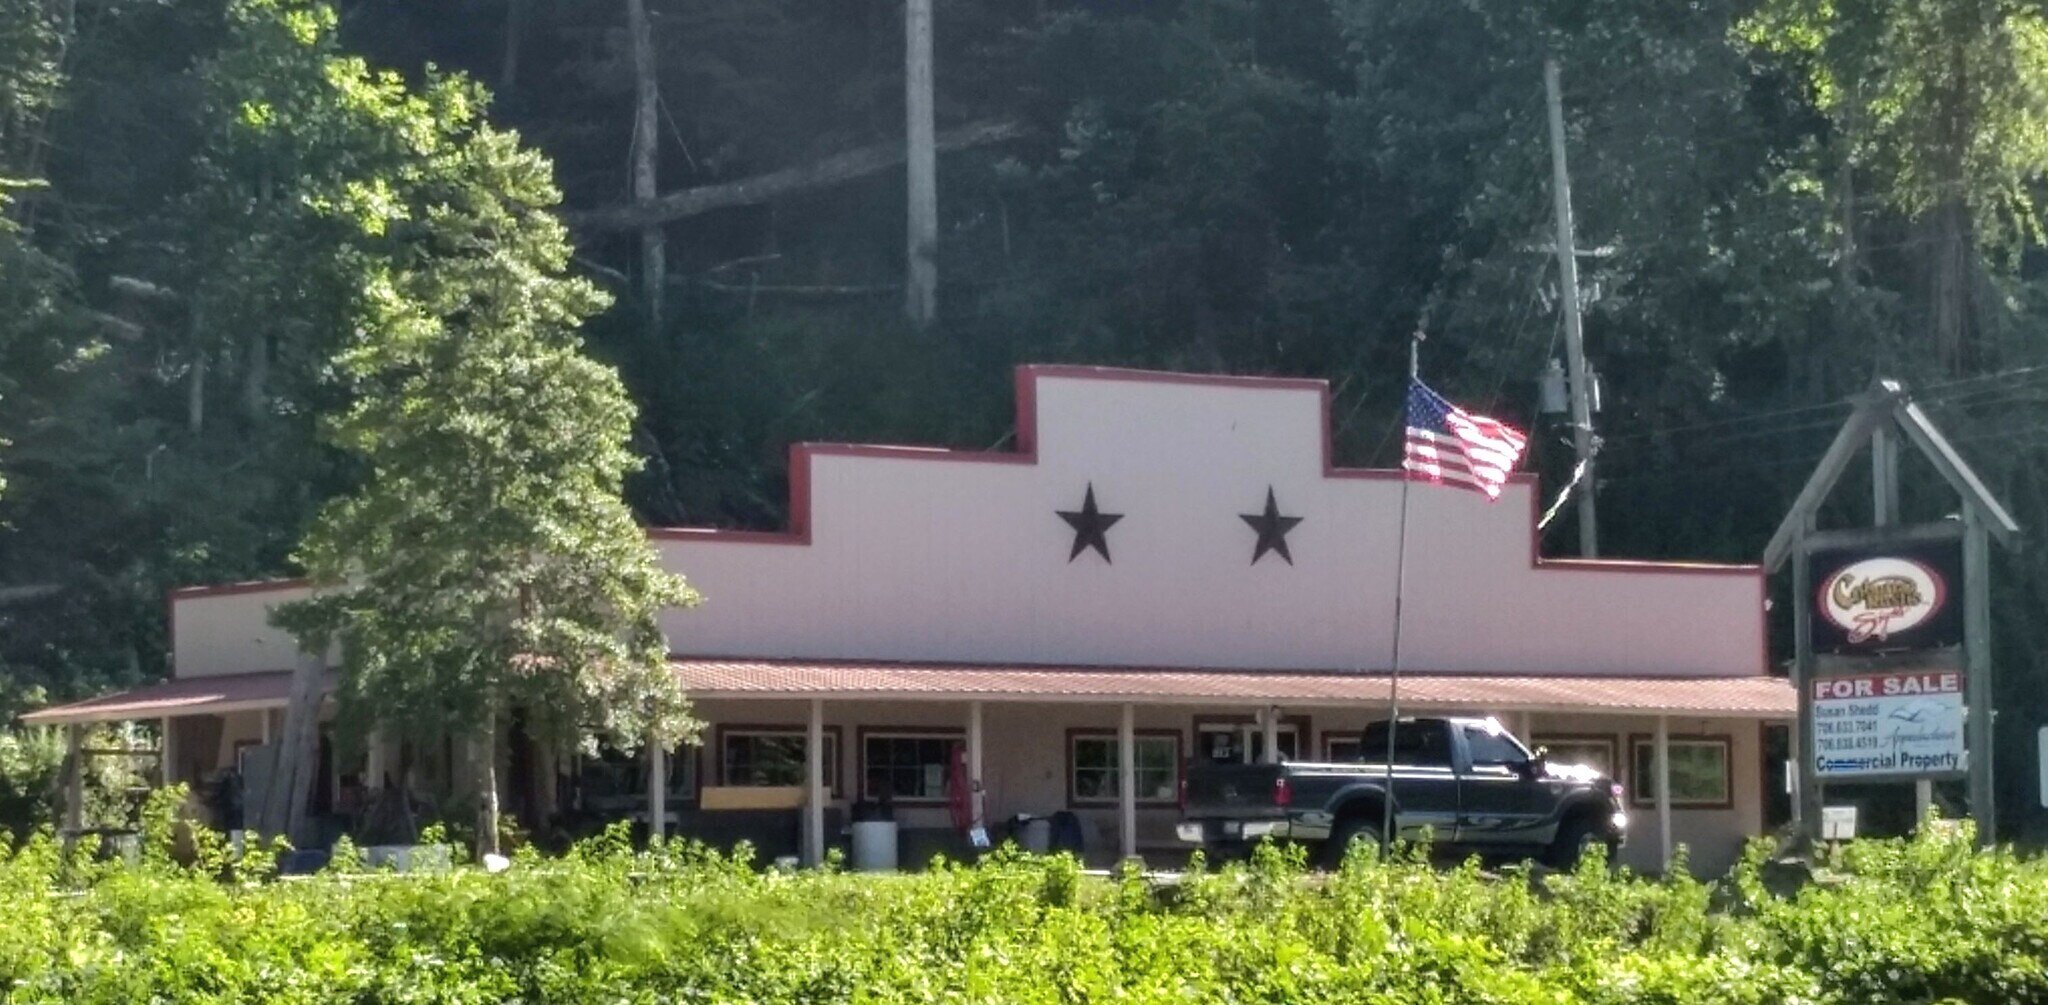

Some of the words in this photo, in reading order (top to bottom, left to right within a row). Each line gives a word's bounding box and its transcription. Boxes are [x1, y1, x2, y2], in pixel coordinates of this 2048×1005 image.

[1816, 679, 1874, 699] FOR
[1883, 674, 1958, 695] SALE
[1901, 752, 1959, 771] Property
